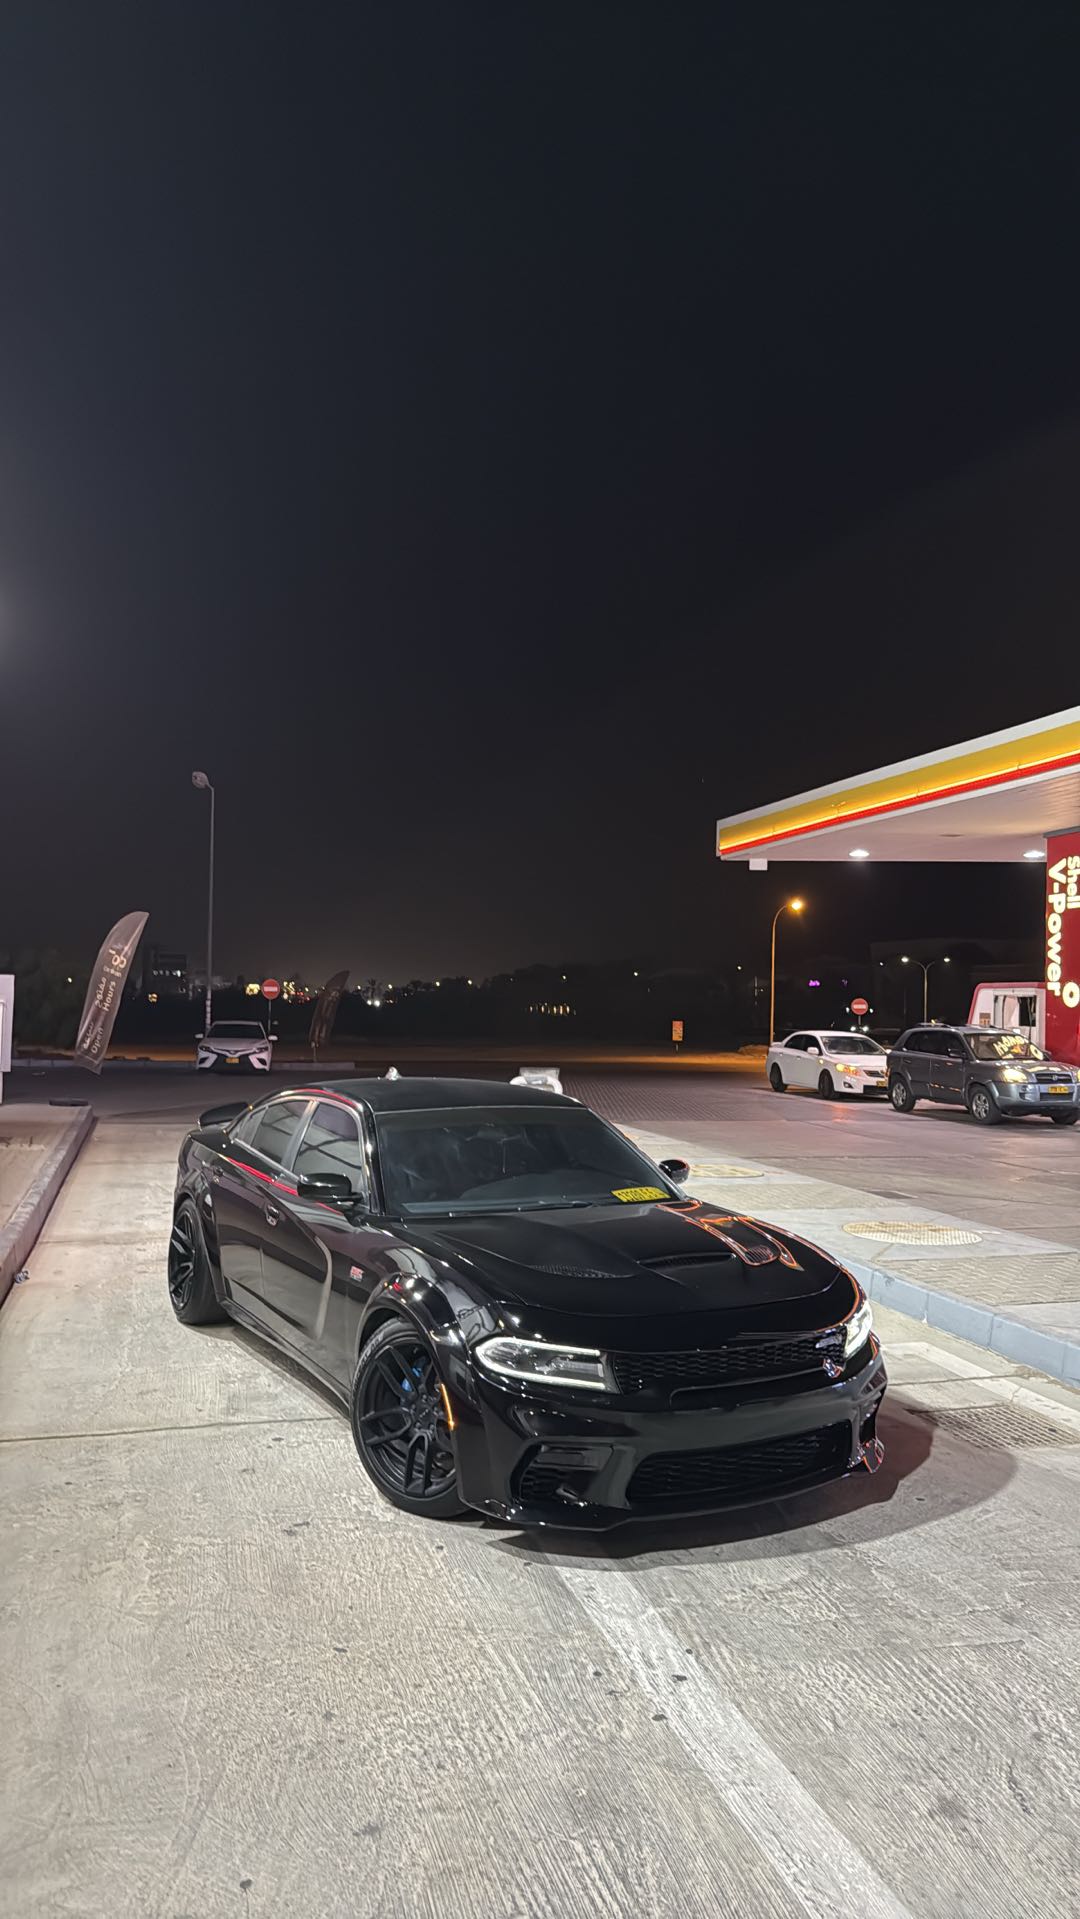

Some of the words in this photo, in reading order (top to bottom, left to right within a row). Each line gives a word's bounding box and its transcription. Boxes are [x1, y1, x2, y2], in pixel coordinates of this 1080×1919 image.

[1048, 858, 1067, 996] V-Power
[91, 1028, 103, 1053] Open
[102, 981, 116, 1012] Hours
